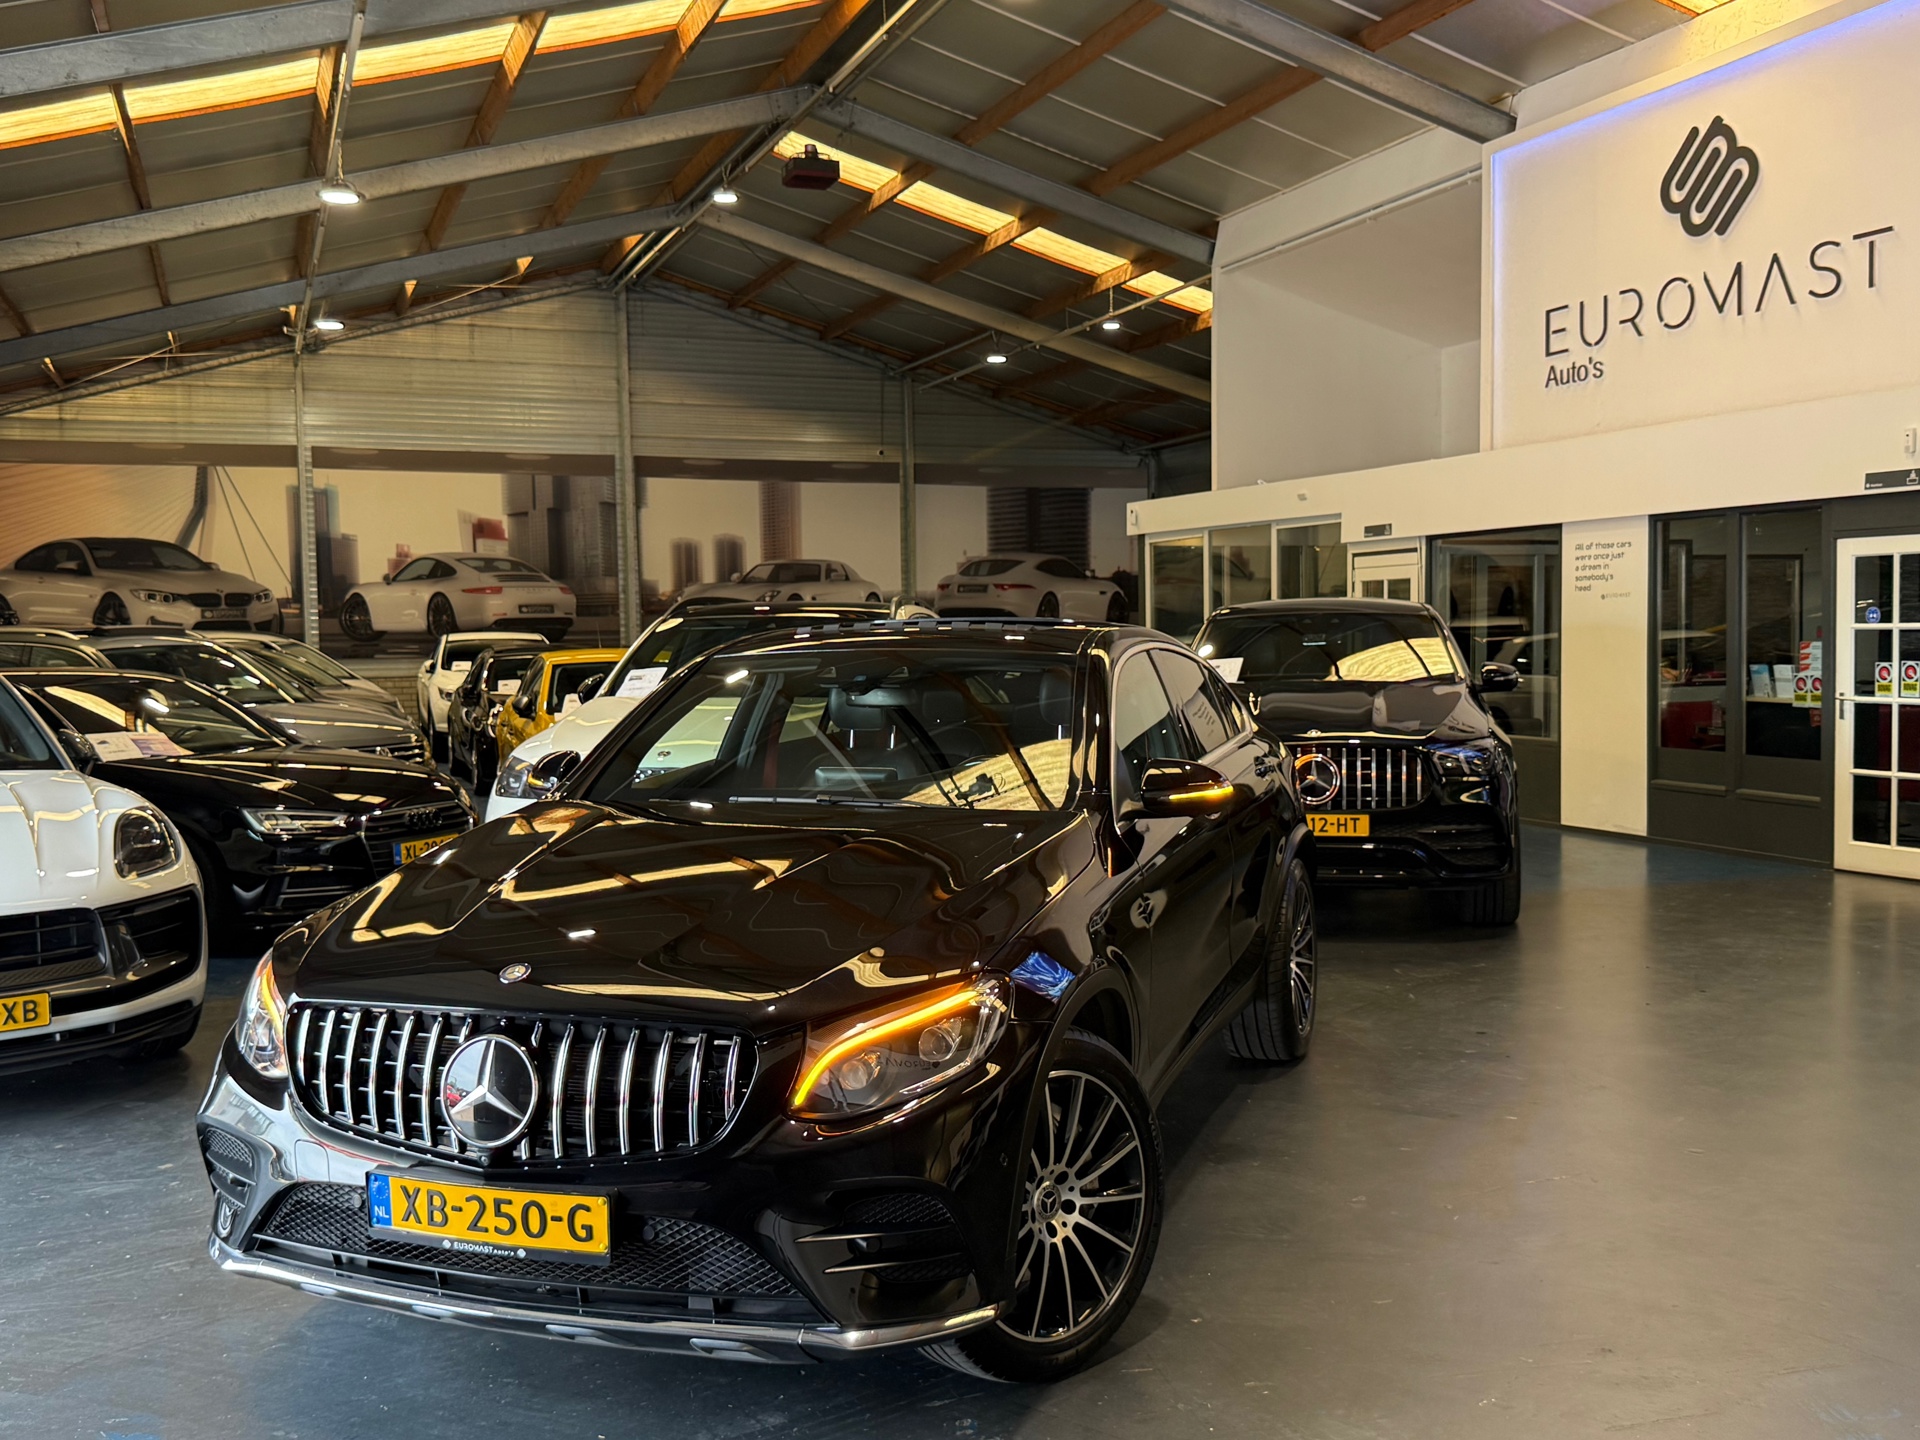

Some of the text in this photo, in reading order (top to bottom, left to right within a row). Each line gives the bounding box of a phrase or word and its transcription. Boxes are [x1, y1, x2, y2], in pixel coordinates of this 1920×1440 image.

[1544, 225, 1894, 358] EUROMAST
[1544, 356, 1605, 389] Auto's
[1575, 543, 1584, 551] All
[1585, 542, 1593, 550] of
[1595, 542, 1615, 550] those
[1610, 552, 1625, 561] just
[1581, 563, 1601, 571] dream
[1575, 573, 1614, 582] somebody's
[1575, 584, 1591, 592] head
[1310, 816, 1360, 833] 12-HT
[374, 1184, 594, 1243] NL XB-250-G
[453, 1241, 493, 1254] EUROMAST
